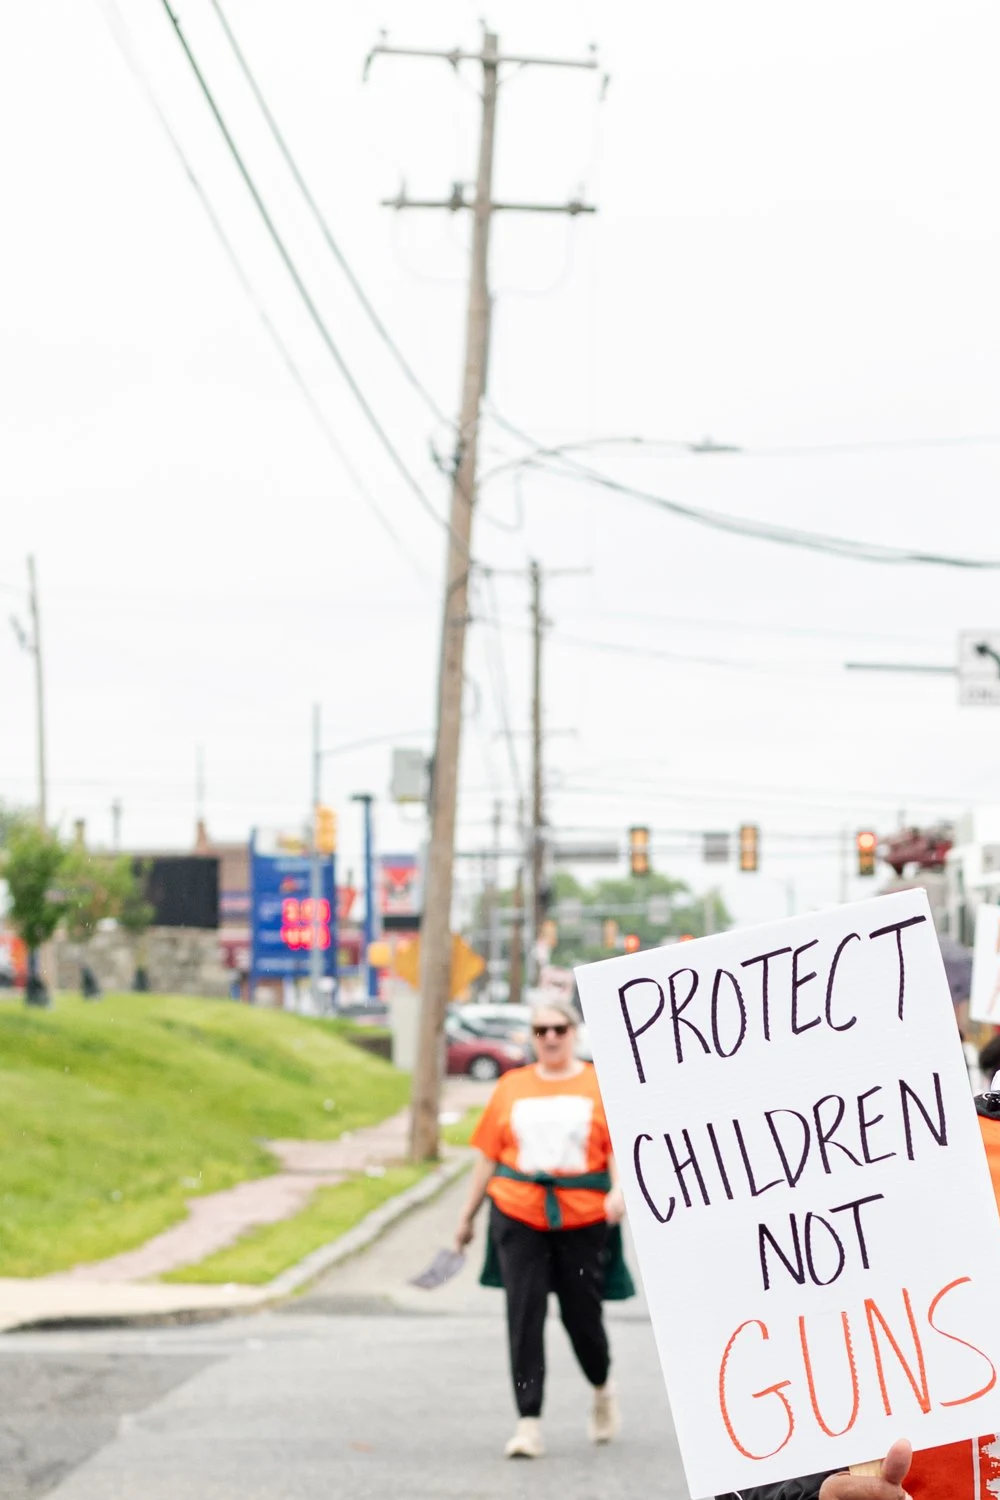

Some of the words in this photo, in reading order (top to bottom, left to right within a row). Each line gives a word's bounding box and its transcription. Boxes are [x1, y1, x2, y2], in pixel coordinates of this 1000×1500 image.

[618, 916, 927, 1084] PROTECT
[634, 1073, 948, 1224] CHILDREN
[758, 1194, 884, 1291] NOT
[719, 1277, 998, 1461] GUNS
